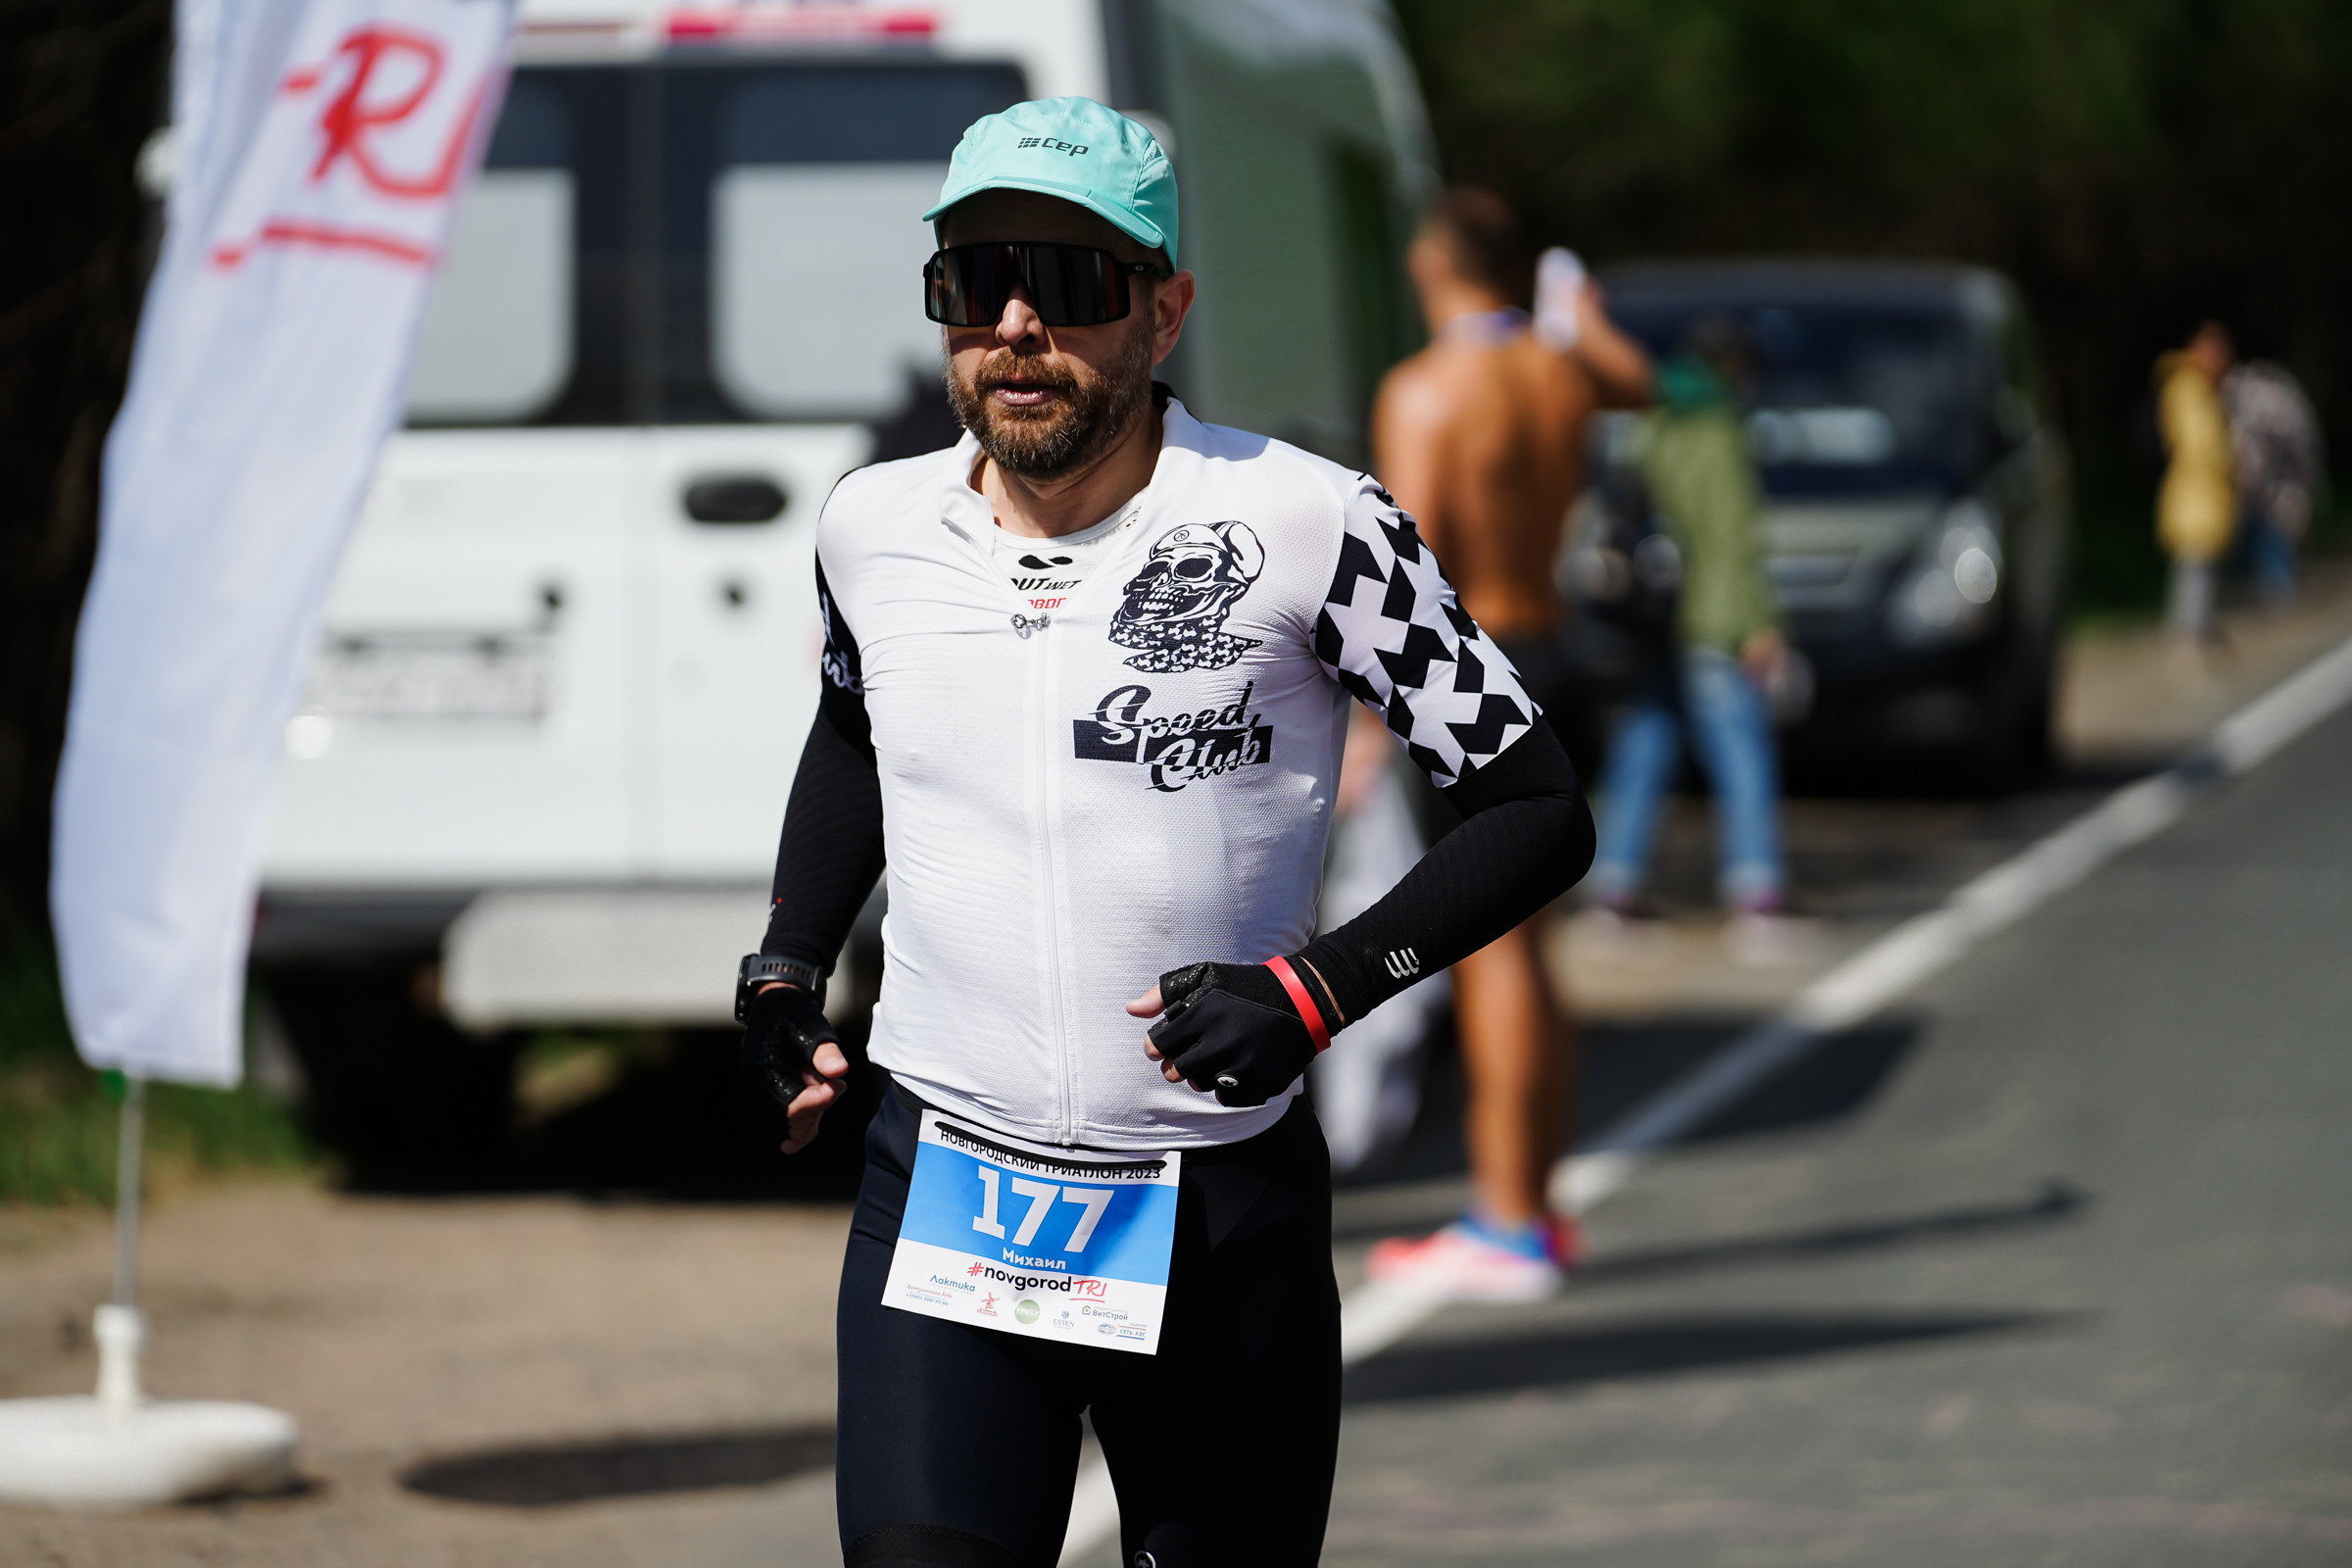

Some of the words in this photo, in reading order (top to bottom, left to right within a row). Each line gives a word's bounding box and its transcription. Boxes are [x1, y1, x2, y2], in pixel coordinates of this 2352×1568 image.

[1010, 577, 1082, 591] UTWET
[1089, 681, 1253, 764] Speed
[1145, 713, 1262, 793] Club
[1126, 1167, 1161, 1180] 2023
[972, 1164, 1115, 1253] 177
[1003, 1247, 1066, 1270] Михаил
[1092, 1309, 1128, 1320] ВитСтрой
